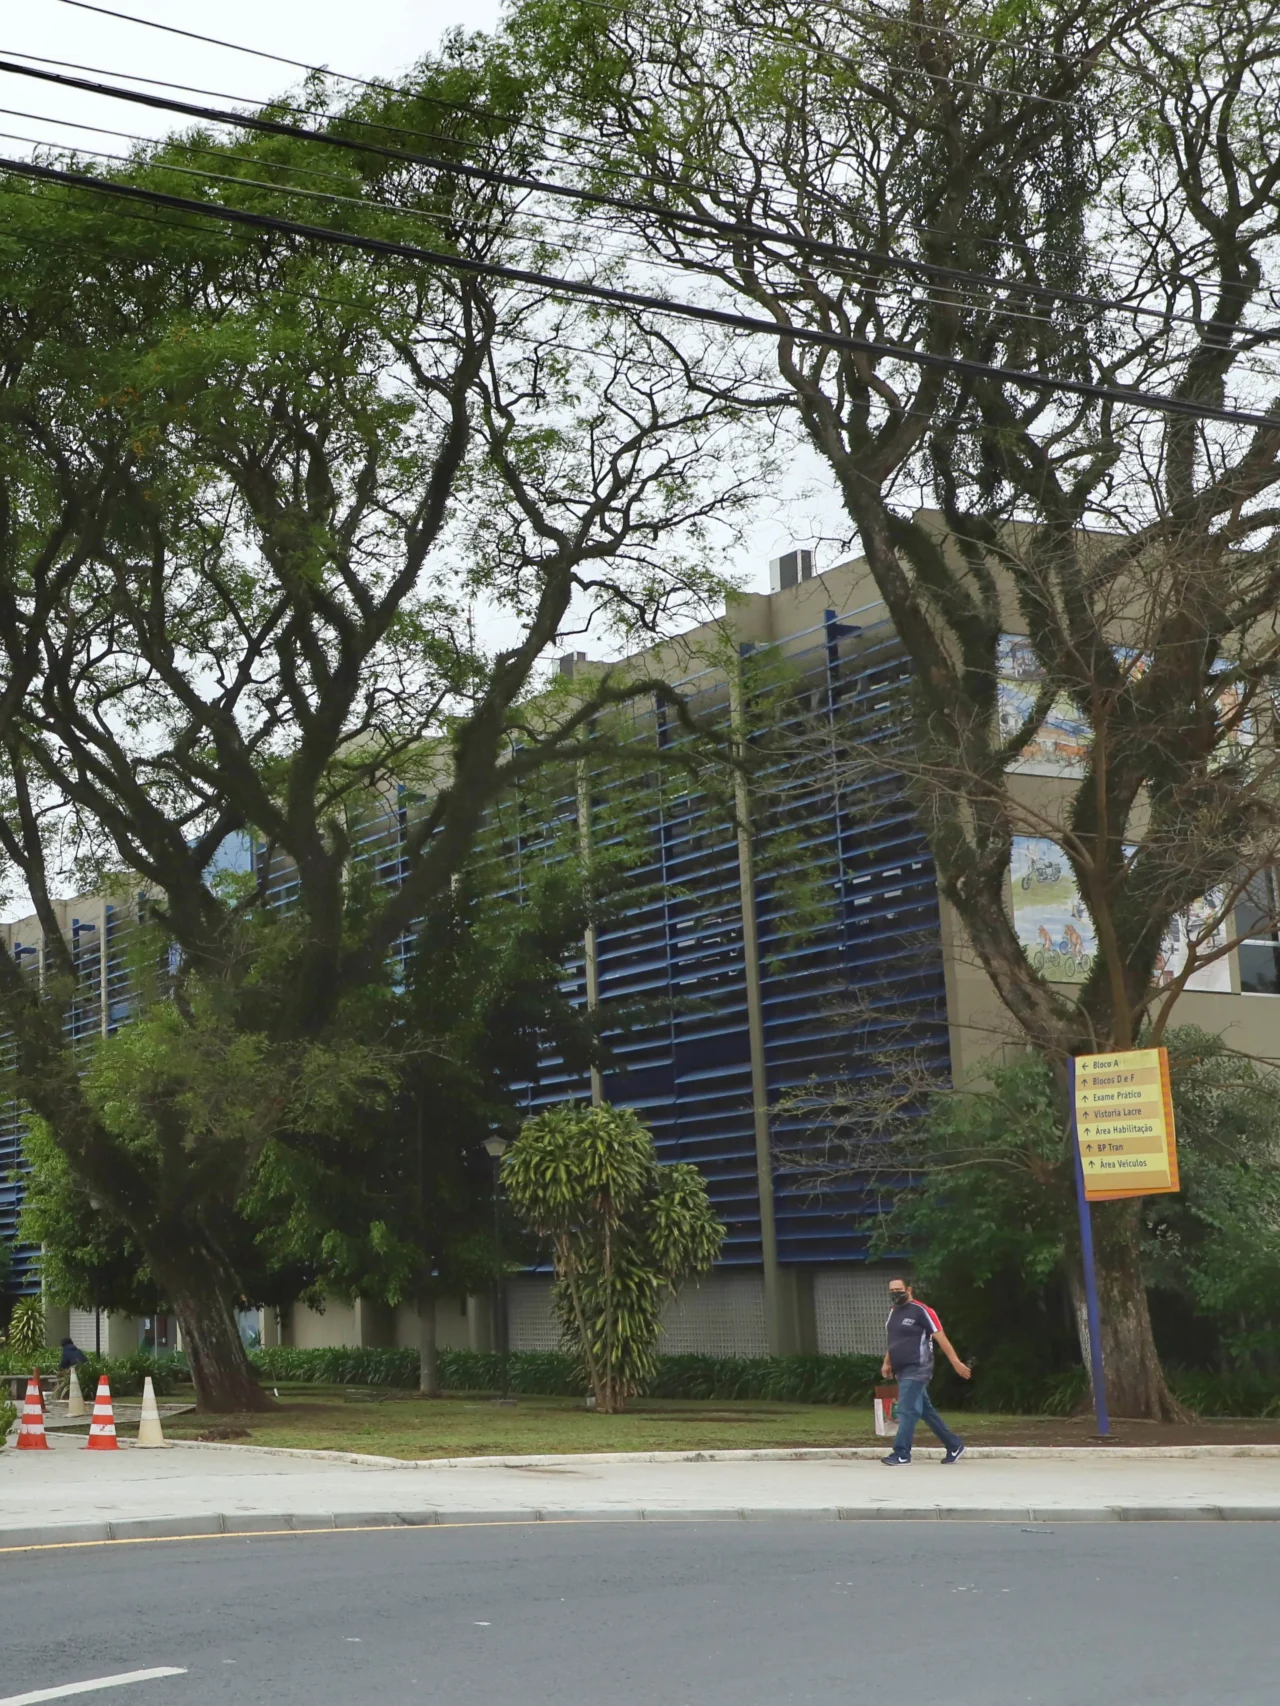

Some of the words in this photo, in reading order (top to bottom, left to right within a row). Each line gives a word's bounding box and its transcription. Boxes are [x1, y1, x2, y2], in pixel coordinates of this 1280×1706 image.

[1093, 1061, 1112, 1070] Bloco
[1113, 1059, 1119, 1067] A
[1092, 1076, 1115, 1086] Blocos
[1116, 1075, 1122, 1083] D
[1130, 1073, 1135, 1082] F
[1093, 1093, 1115, 1102] Exame
[1117, 1090, 1142, 1100] Prático
[1094, 1108, 1121, 1119] Vistoria
[1123, 1108, 1142, 1116] Lacre
[1095, 1124, 1111, 1135] Área
[1113, 1123, 1153, 1134] Habilitação
[1097, 1144, 1107, 1152] BP
[1108, 1143, 1124, 1152] Tran
[1100, 1159, 1116, 1169] Área
[1117, 1159, 1147, 1168] Veículos
